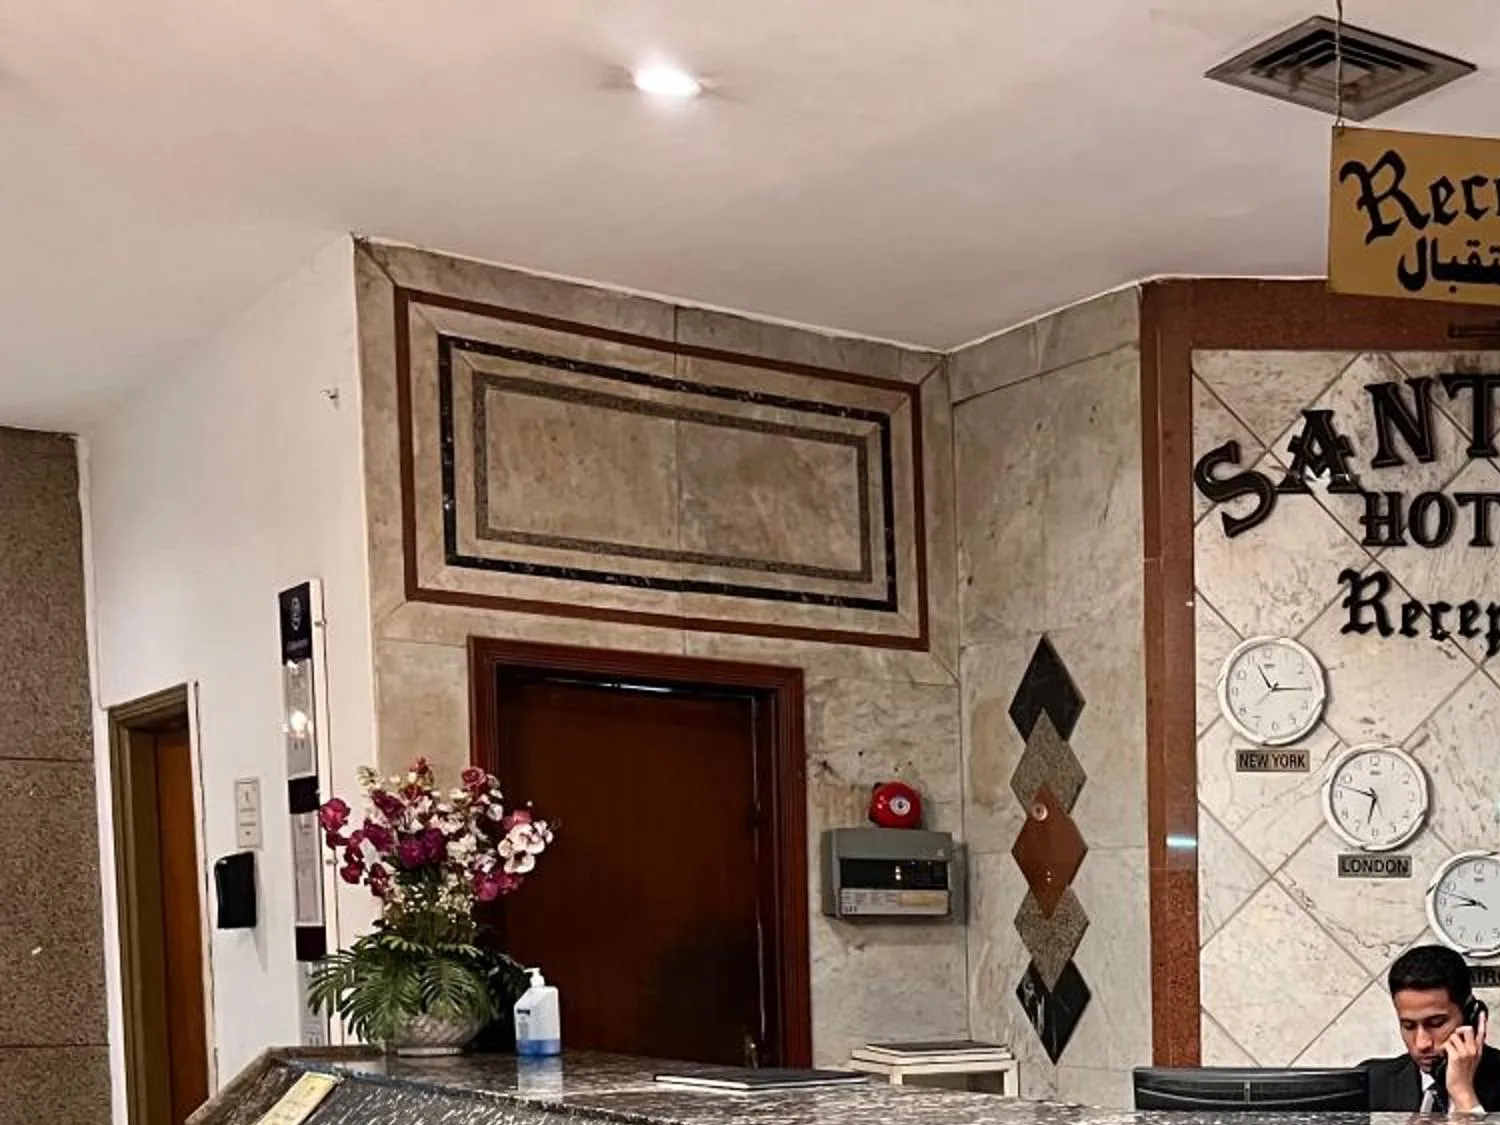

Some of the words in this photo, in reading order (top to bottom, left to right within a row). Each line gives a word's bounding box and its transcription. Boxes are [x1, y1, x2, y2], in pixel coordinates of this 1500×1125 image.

[1239, 752, 1270, 769] NEW
[1271, 752, 1306, 769] YORK
[1341, 858, 1410, 873] LONDON
